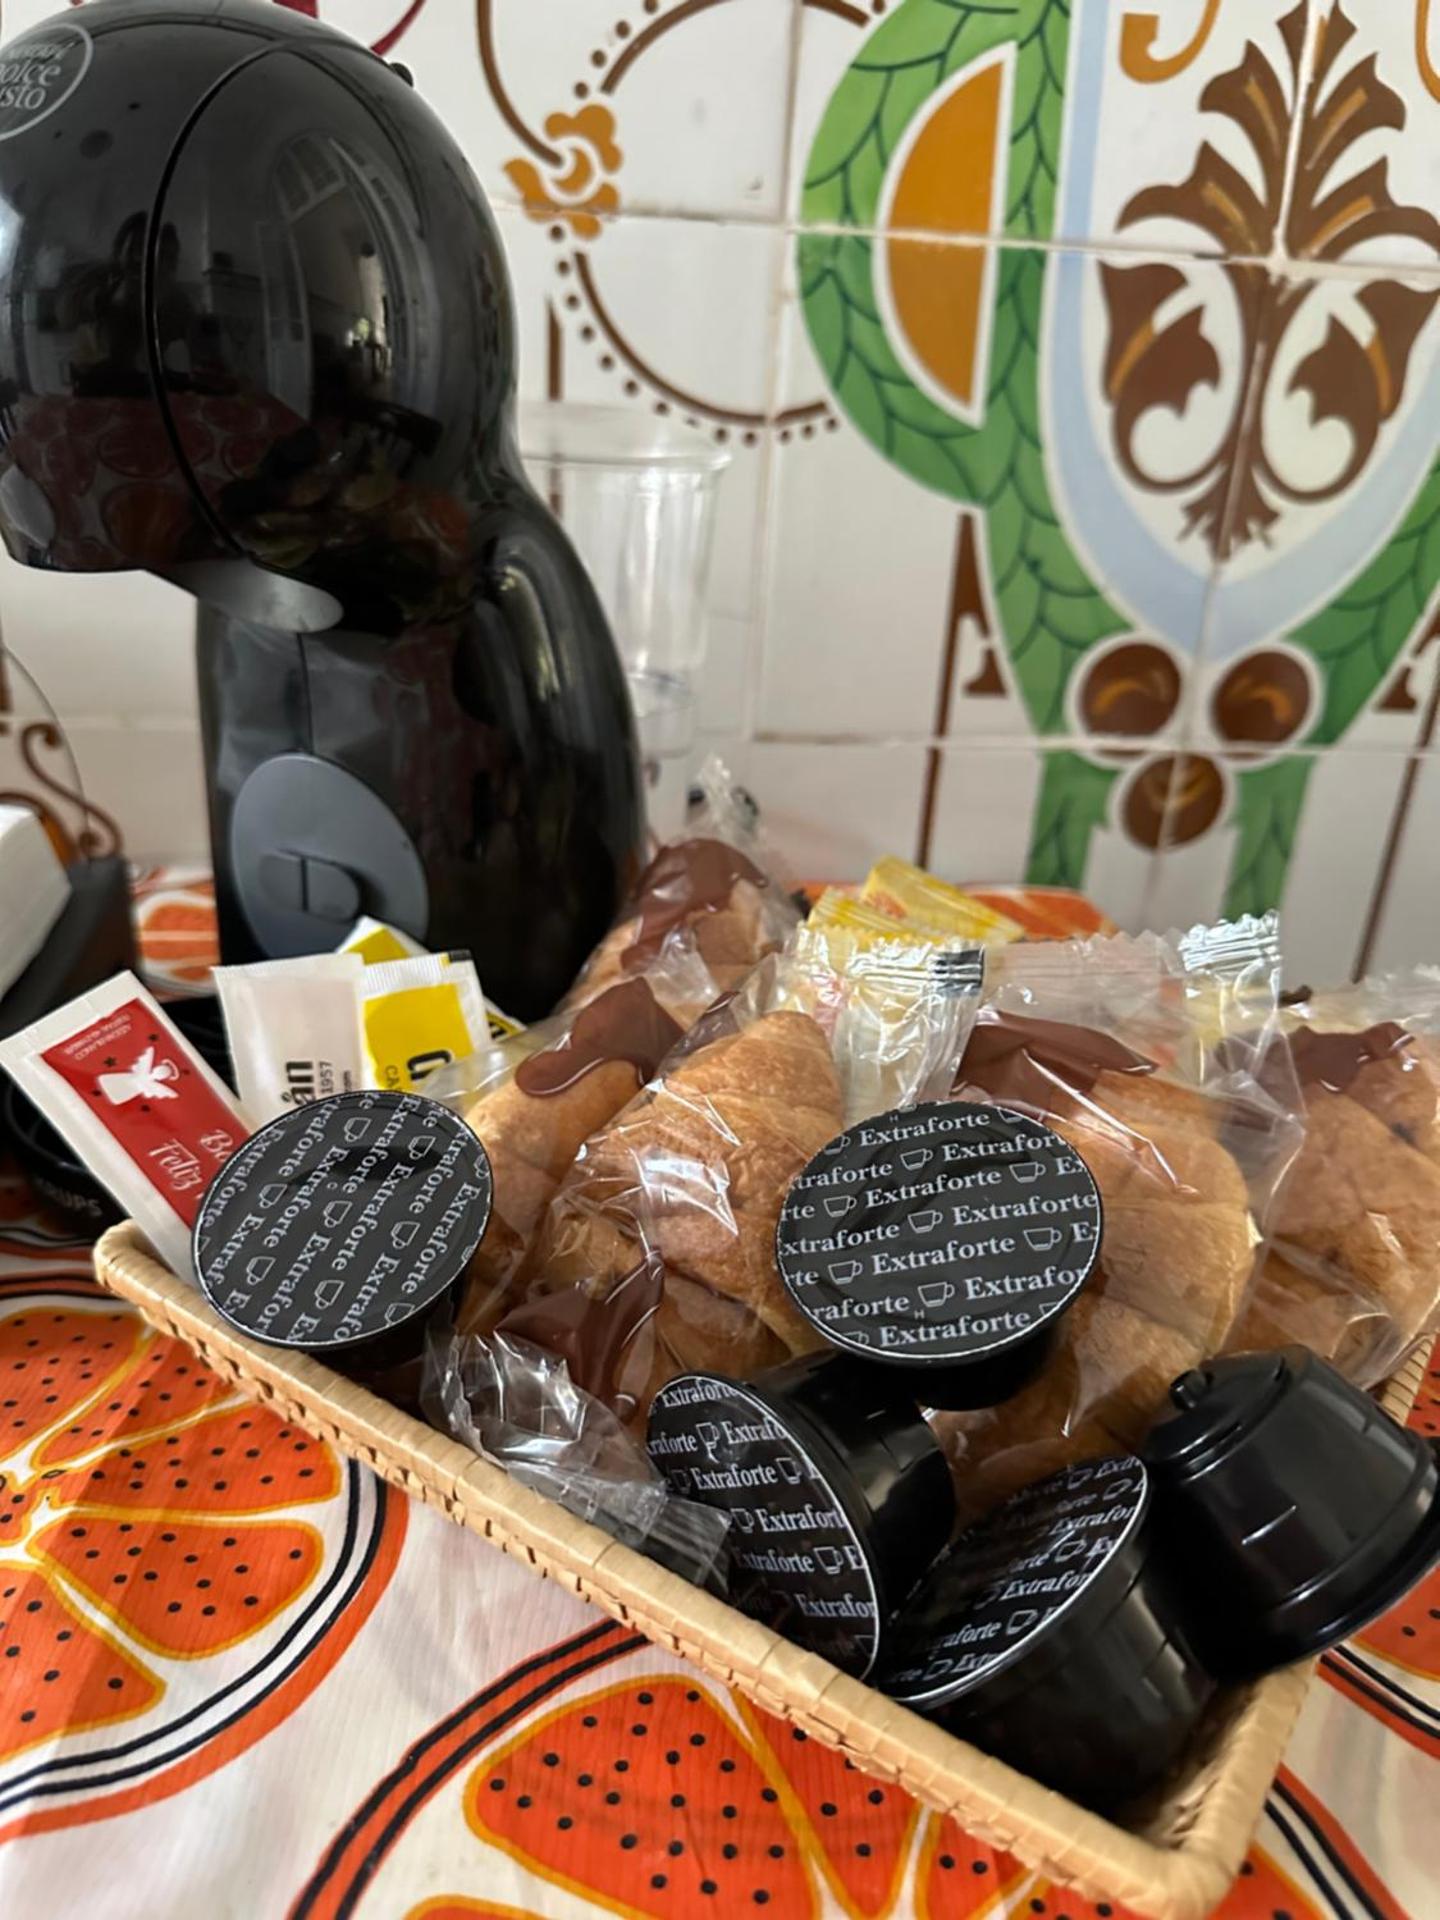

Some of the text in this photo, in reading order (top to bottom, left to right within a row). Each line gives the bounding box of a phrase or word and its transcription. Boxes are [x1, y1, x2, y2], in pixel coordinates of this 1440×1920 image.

[319, 1061, 333, 1093] 1957
[342, 1097, 420, 1193] Extraforte
[860, 1113, 990, 1147] Extraforte
[203, 1128, 285, 1227] Extraforte
[263, 1146, 349, 1248] Extraforte
[864, 1170, 1002, 1208] Extraforte
[332, 1162, 414, 1270] Extraforte
[952, 1192, 1098, 1226] Extraforte
[402, 1182, 480, 1294] Extraforte
[872, 1234, 1016, 1275] Extraforte
[879, 1310, 1031, 1348] Extraforte
[691, 1463, 778, 1491] Extraforte
